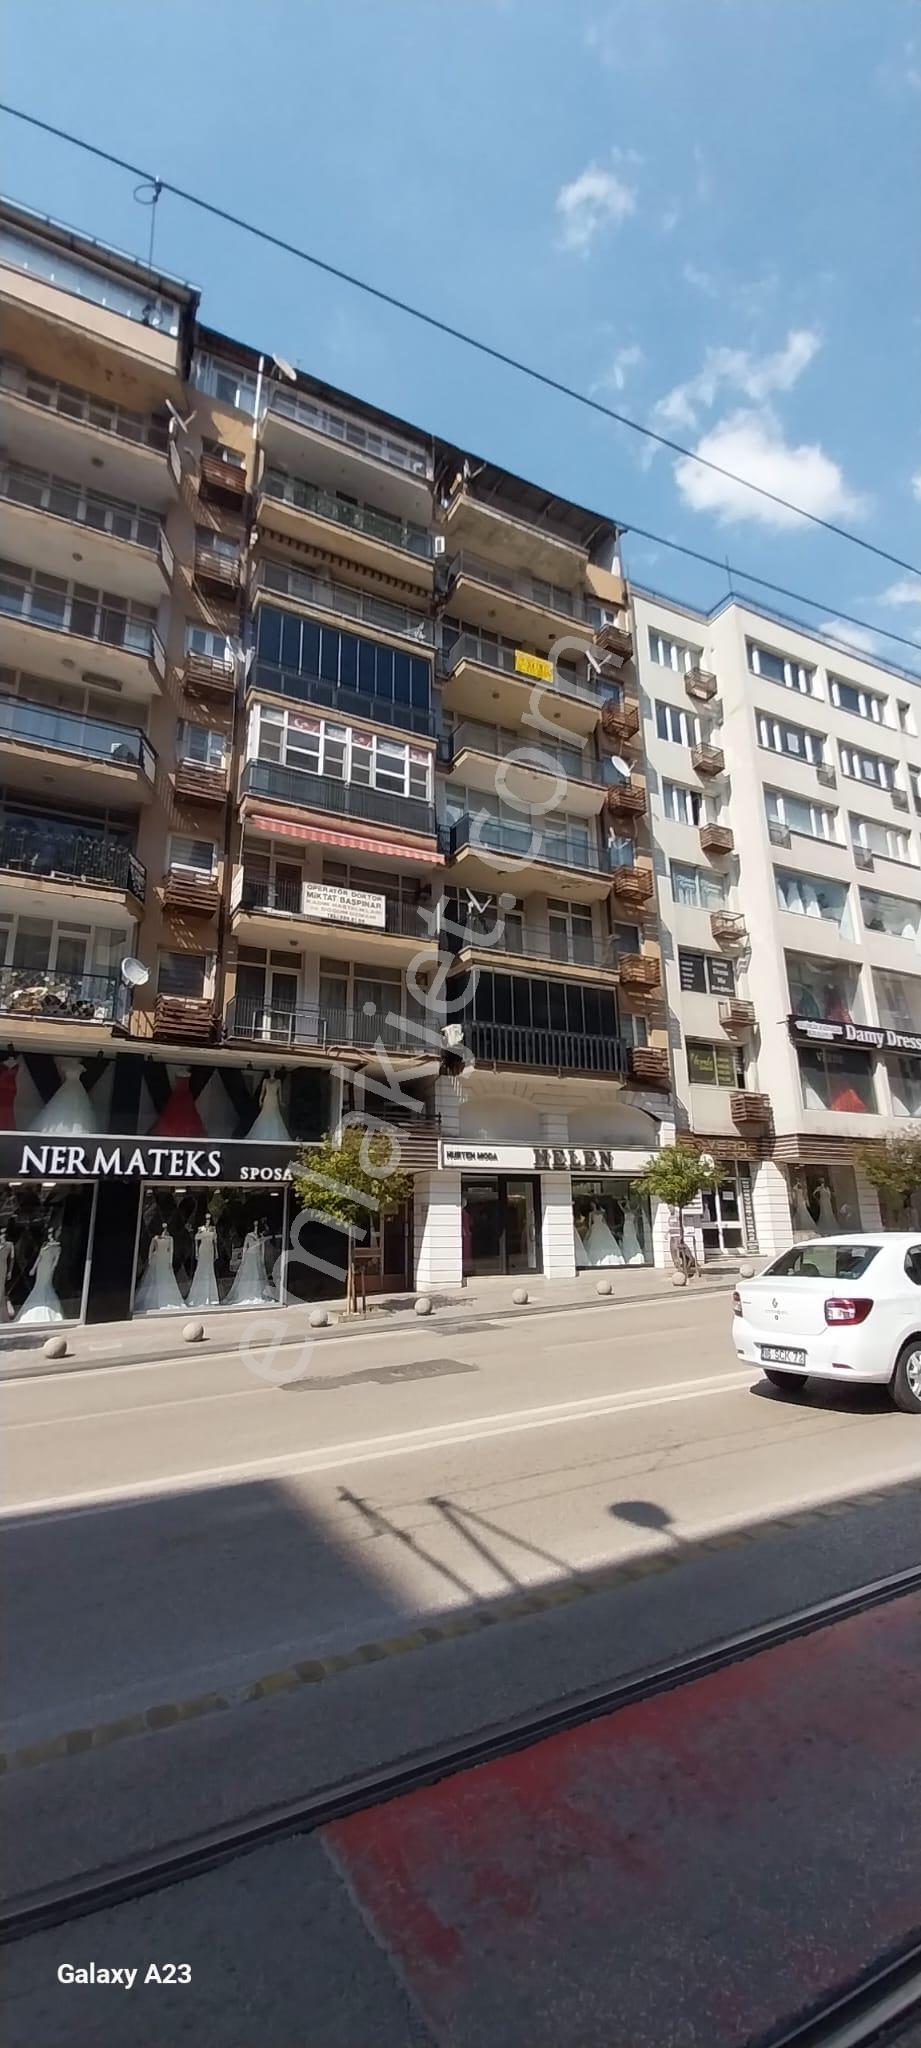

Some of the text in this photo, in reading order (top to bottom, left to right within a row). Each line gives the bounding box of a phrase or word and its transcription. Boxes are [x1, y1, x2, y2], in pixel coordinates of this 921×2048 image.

[845, 1024, 884, 1048] Damy
[886, 1030, 921, 1050] Dress
[18, 1145, 222, 1178] NERMATEKS
[446, 1151, 498, 1161] NURTEN MODA
[533, 1148, 614, 1171] HELEN
[239, 1166, 294, 1181] SPOSA
